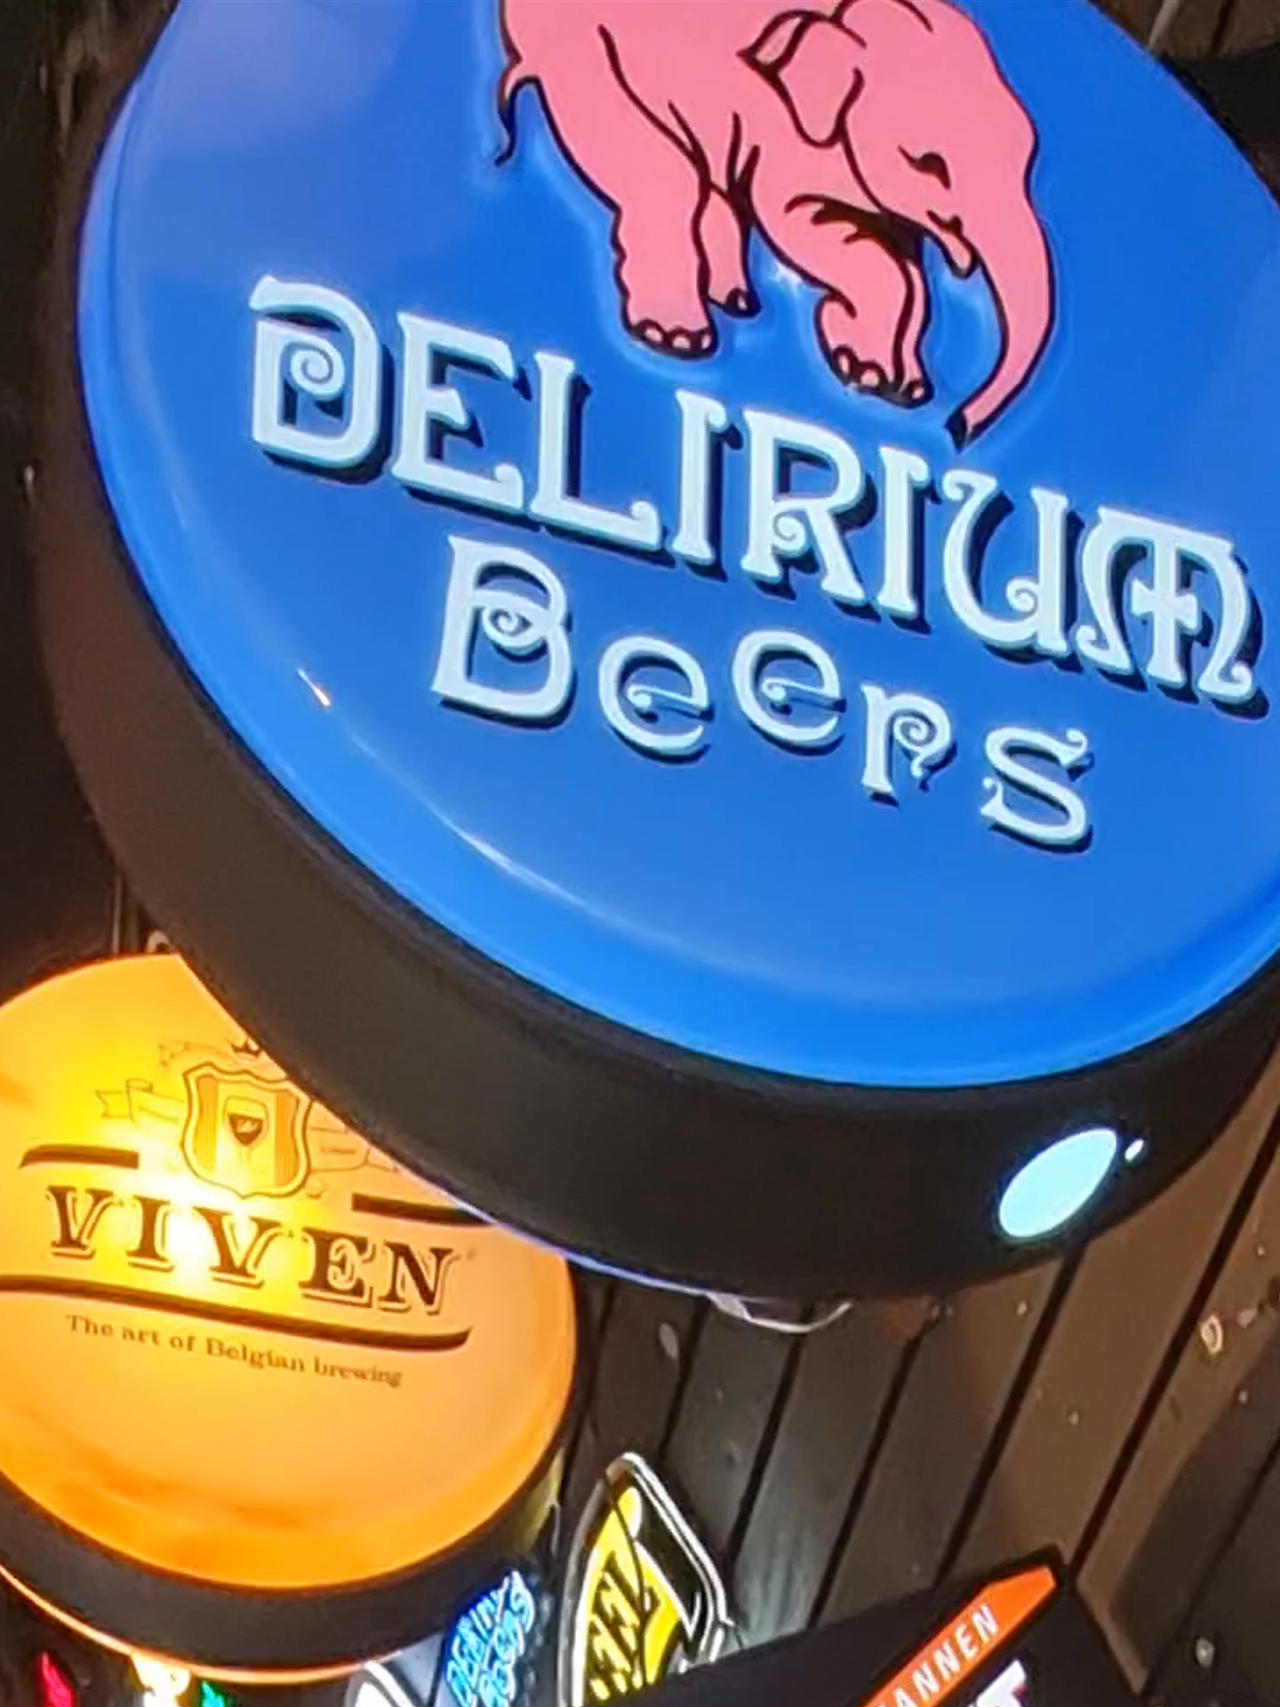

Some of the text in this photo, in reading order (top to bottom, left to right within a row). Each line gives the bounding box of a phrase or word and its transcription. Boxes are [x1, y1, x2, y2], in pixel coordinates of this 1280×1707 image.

[248, 275, 1265, 714] DELIRIUM
[430, 533, 1095, 850] Beers
[46, 1184, 456, 1316] VIVEN
[66, 1314, 404, 1388] The art of Belgian brewing
